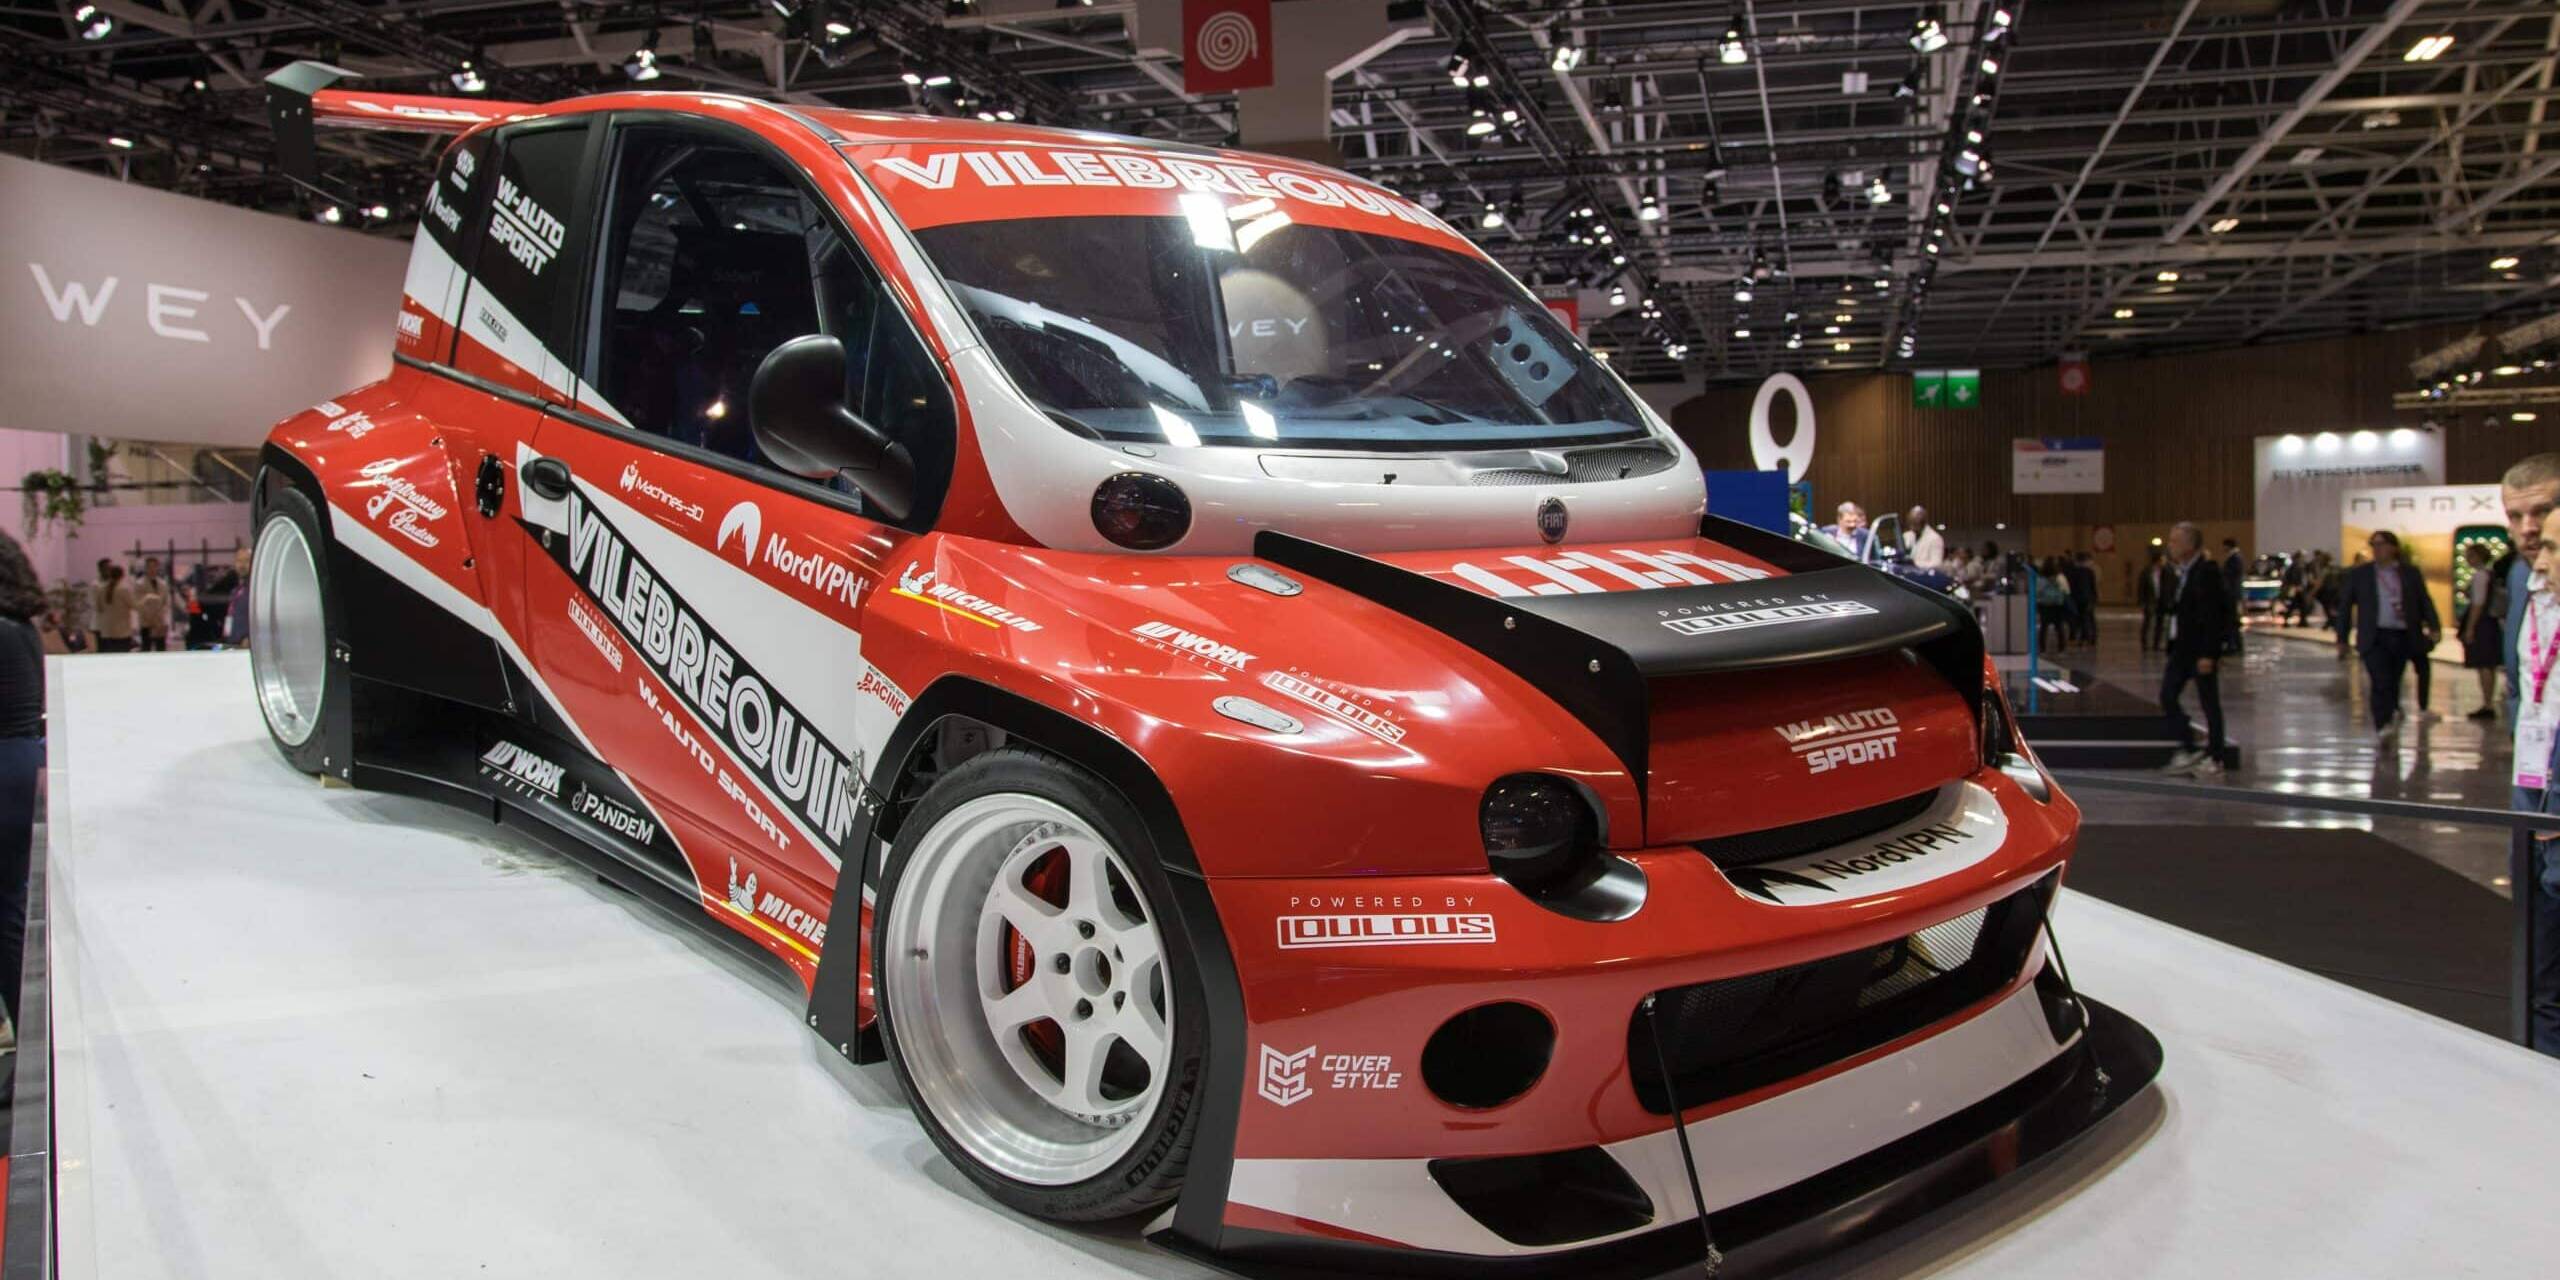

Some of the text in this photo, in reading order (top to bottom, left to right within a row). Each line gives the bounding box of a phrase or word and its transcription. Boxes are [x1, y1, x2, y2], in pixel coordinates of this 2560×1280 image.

[497, 174, 566, 250] W-AUTO
[874, 150, 1460, 239] VILEBREQUIN
[489, 213, 548, 276] SPORT
[28, 262, 291, 350] WEY
[1544, 512, 1565, 529] FIAT
[927, 583, 1044, 632] MICHELIN
[1657, 597, 1785, 618] POWERED
[568, 497, 857, 847] VILEBREQUIN
[1136, 636, 1229, 673] WHEELS
[1169, 629, 1260, 669] WORK
[857, 671, 905, 717] RACING
[1289, 666, 1372, 706] POWERED
[1774, 707, 1899, 743] W-AUTO
[509, 745, 567, 793] WORK
[638, 678, 791, 852] W-AUTO SPORT
[1807, 736, 1899, 775] SPORT
[1810, 821, 1975, 880] NordVPN
[758, 891, 828, 949] MICHE
[1291, 897, 1475, 908] POWERED BY
[1321, 1055, 1392, 1072] COVER
[1331, 1073, 1402, 1089] STYLE
